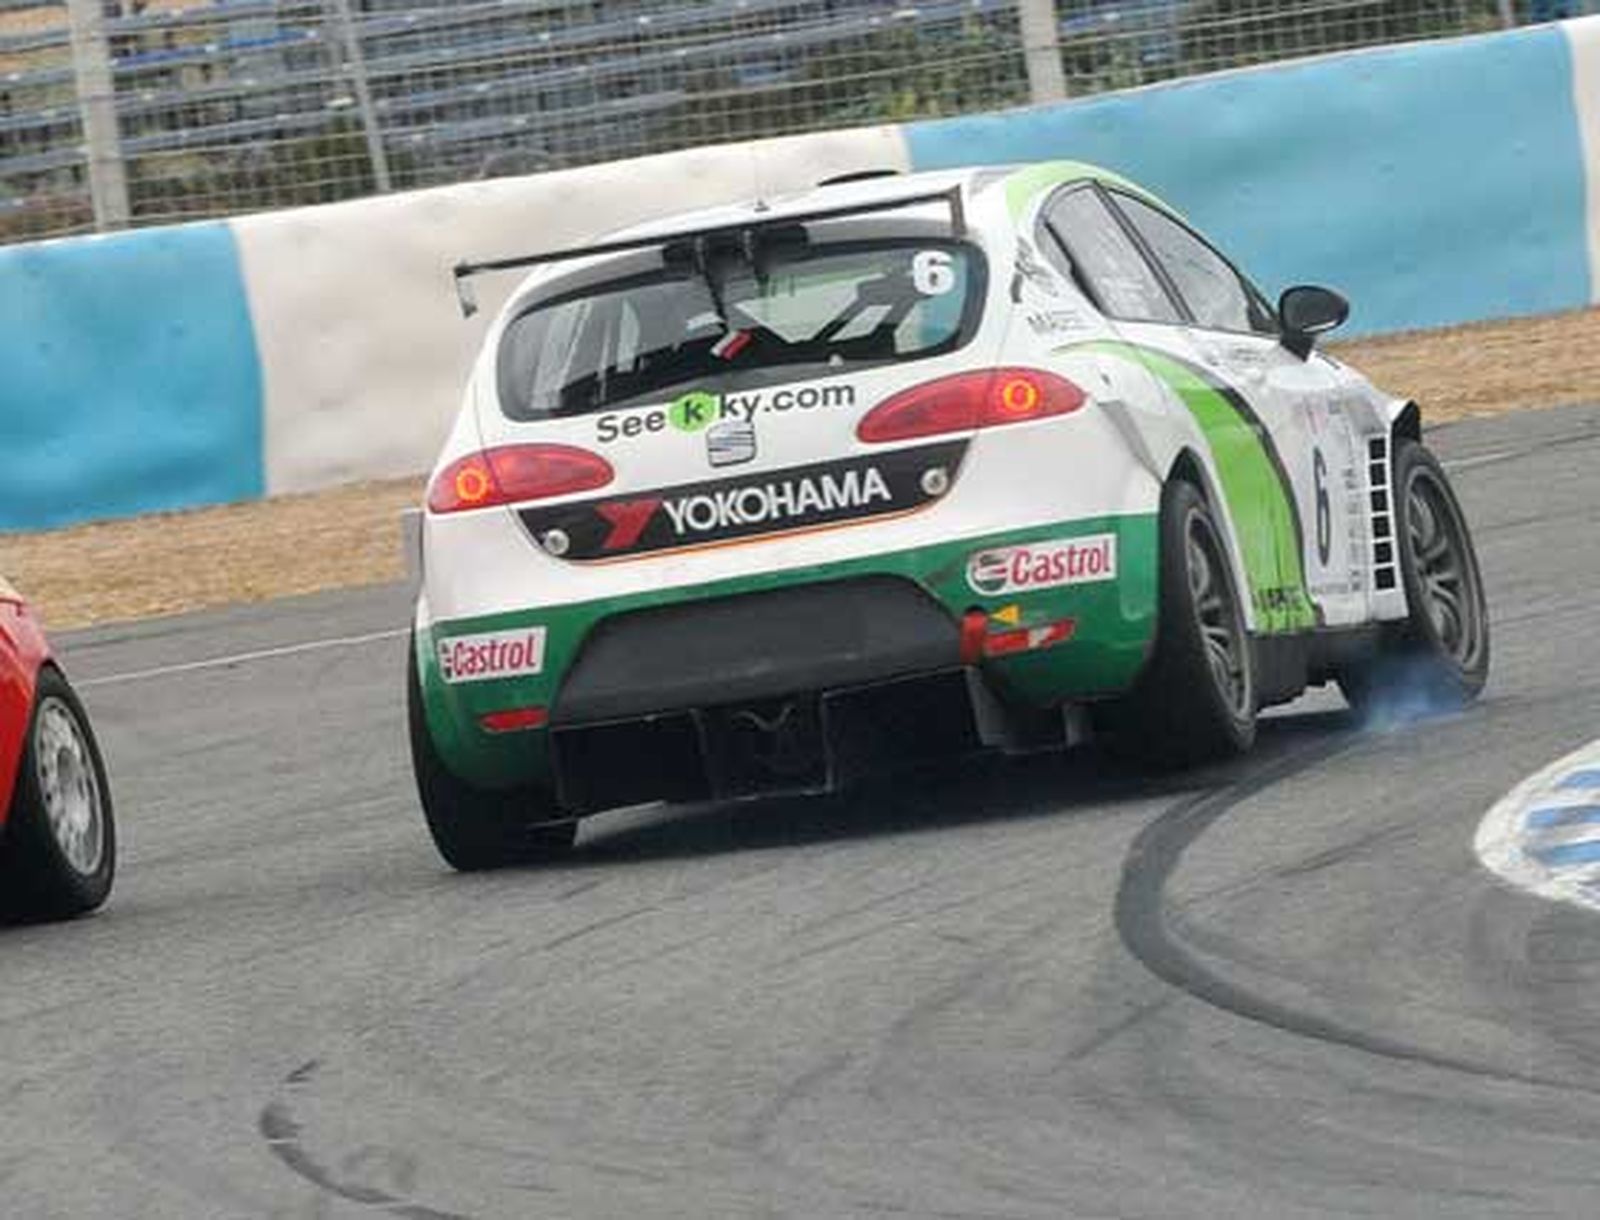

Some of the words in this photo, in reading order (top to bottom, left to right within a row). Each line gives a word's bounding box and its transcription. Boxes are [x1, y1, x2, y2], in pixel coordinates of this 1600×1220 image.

[913, 250, 954, 295] 6
[663, 467, 892, 535] YOKOHAMA
[1313, 445, 1330, 567] 6
[1011, 538, 1111, 586] Castrol
[453, 634, 537, 677] Castrol
